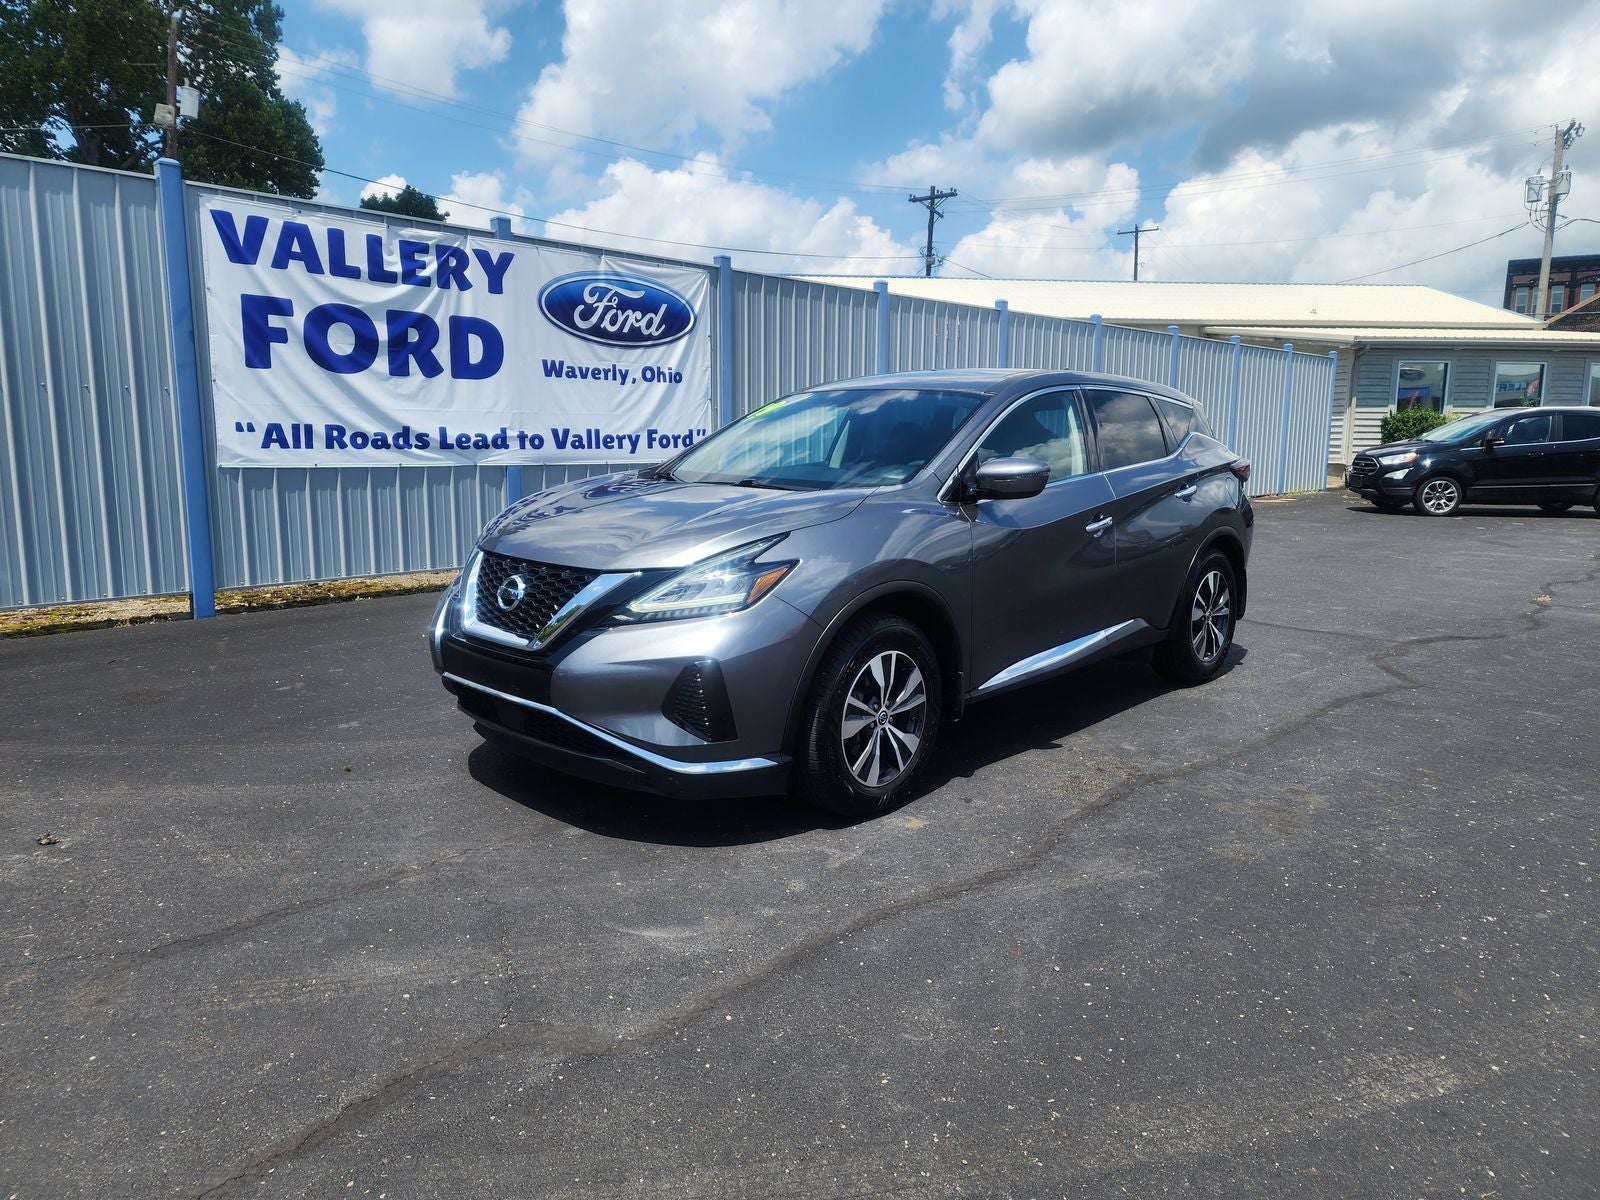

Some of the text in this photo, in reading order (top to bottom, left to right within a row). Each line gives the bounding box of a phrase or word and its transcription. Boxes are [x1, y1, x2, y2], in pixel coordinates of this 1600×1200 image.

[209, 209, 515, 295] VALLERY
[573, 282, 667, 336] Ford
[240, 293, 505, 381] FORD
[641, 366, 683, 384] Ohio
[324, 424, 432, 451] Roads
[438, 426, 509, 450] Lead
[516, 430, 545, 450] to
[550, 427, 641, 455] Vallery
